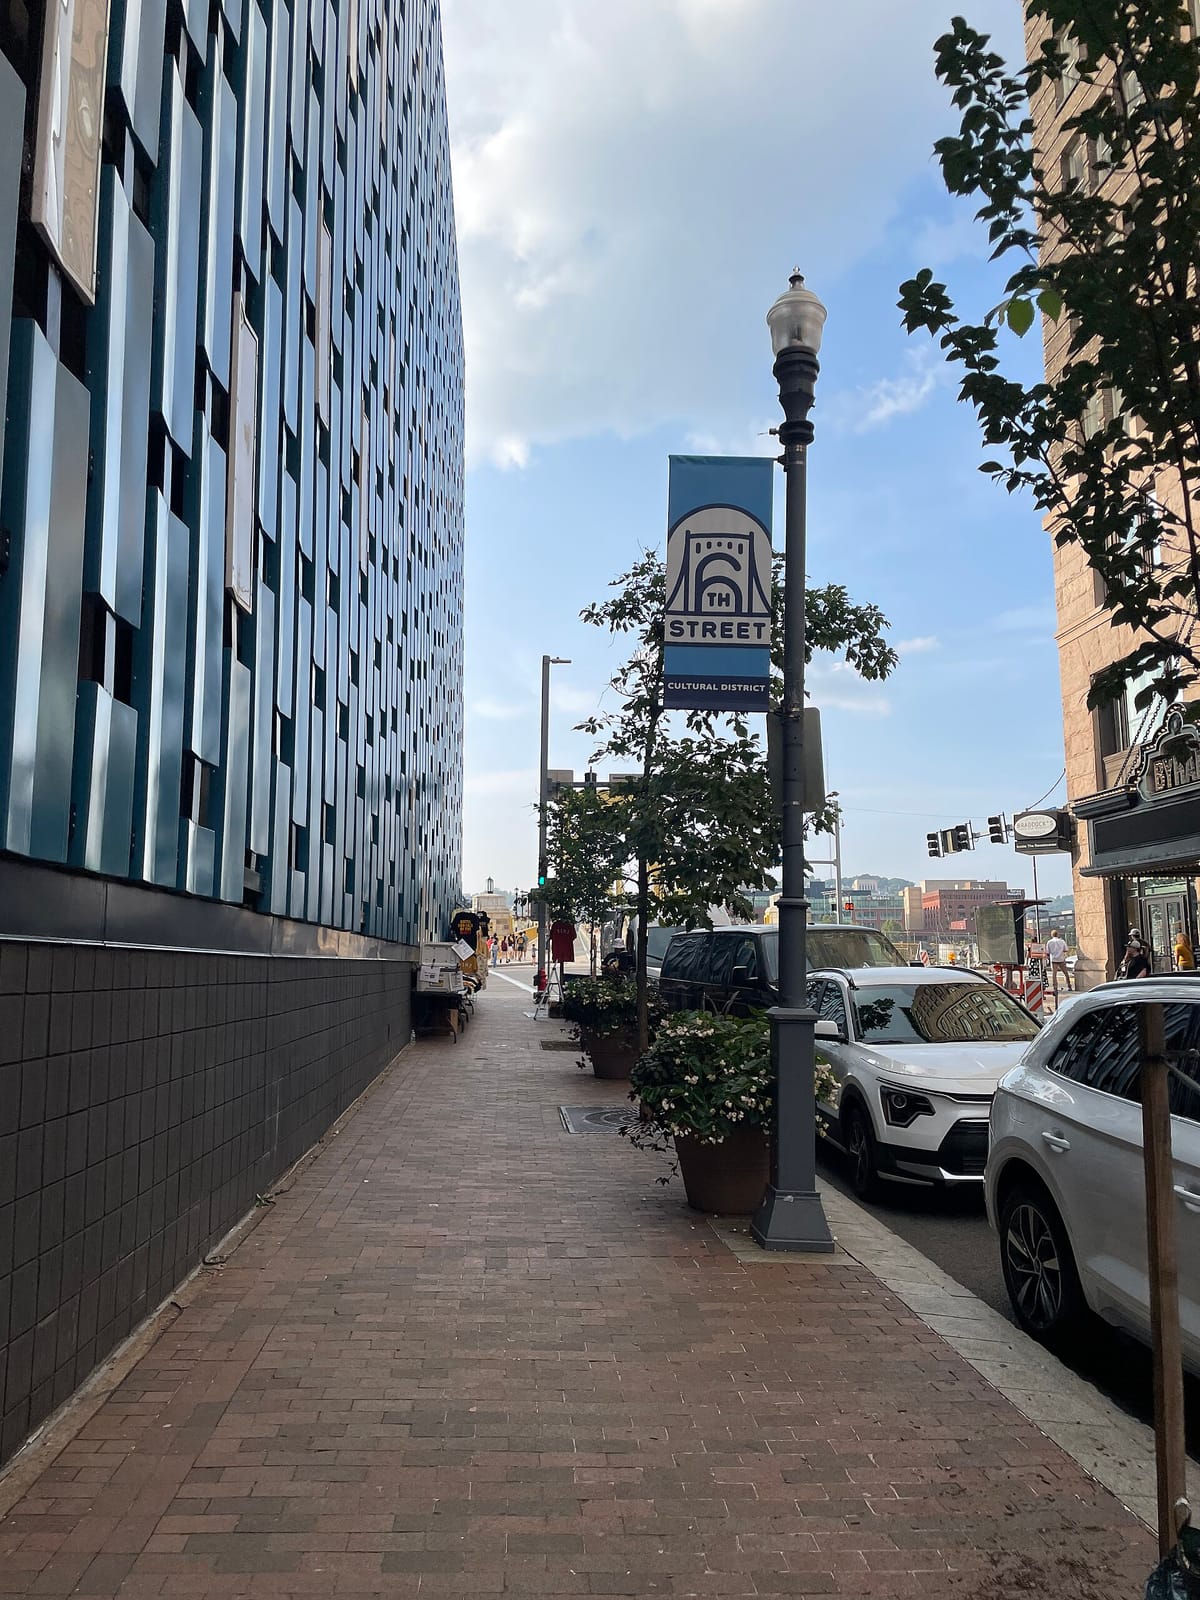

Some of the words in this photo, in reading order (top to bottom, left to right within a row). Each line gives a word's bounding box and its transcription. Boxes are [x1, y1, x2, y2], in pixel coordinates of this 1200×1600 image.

[669, 620, 766, 639] STREET
[667, 682, 719, 691] CULTURAL
[720, 683, 766, 692] DISTRICT
